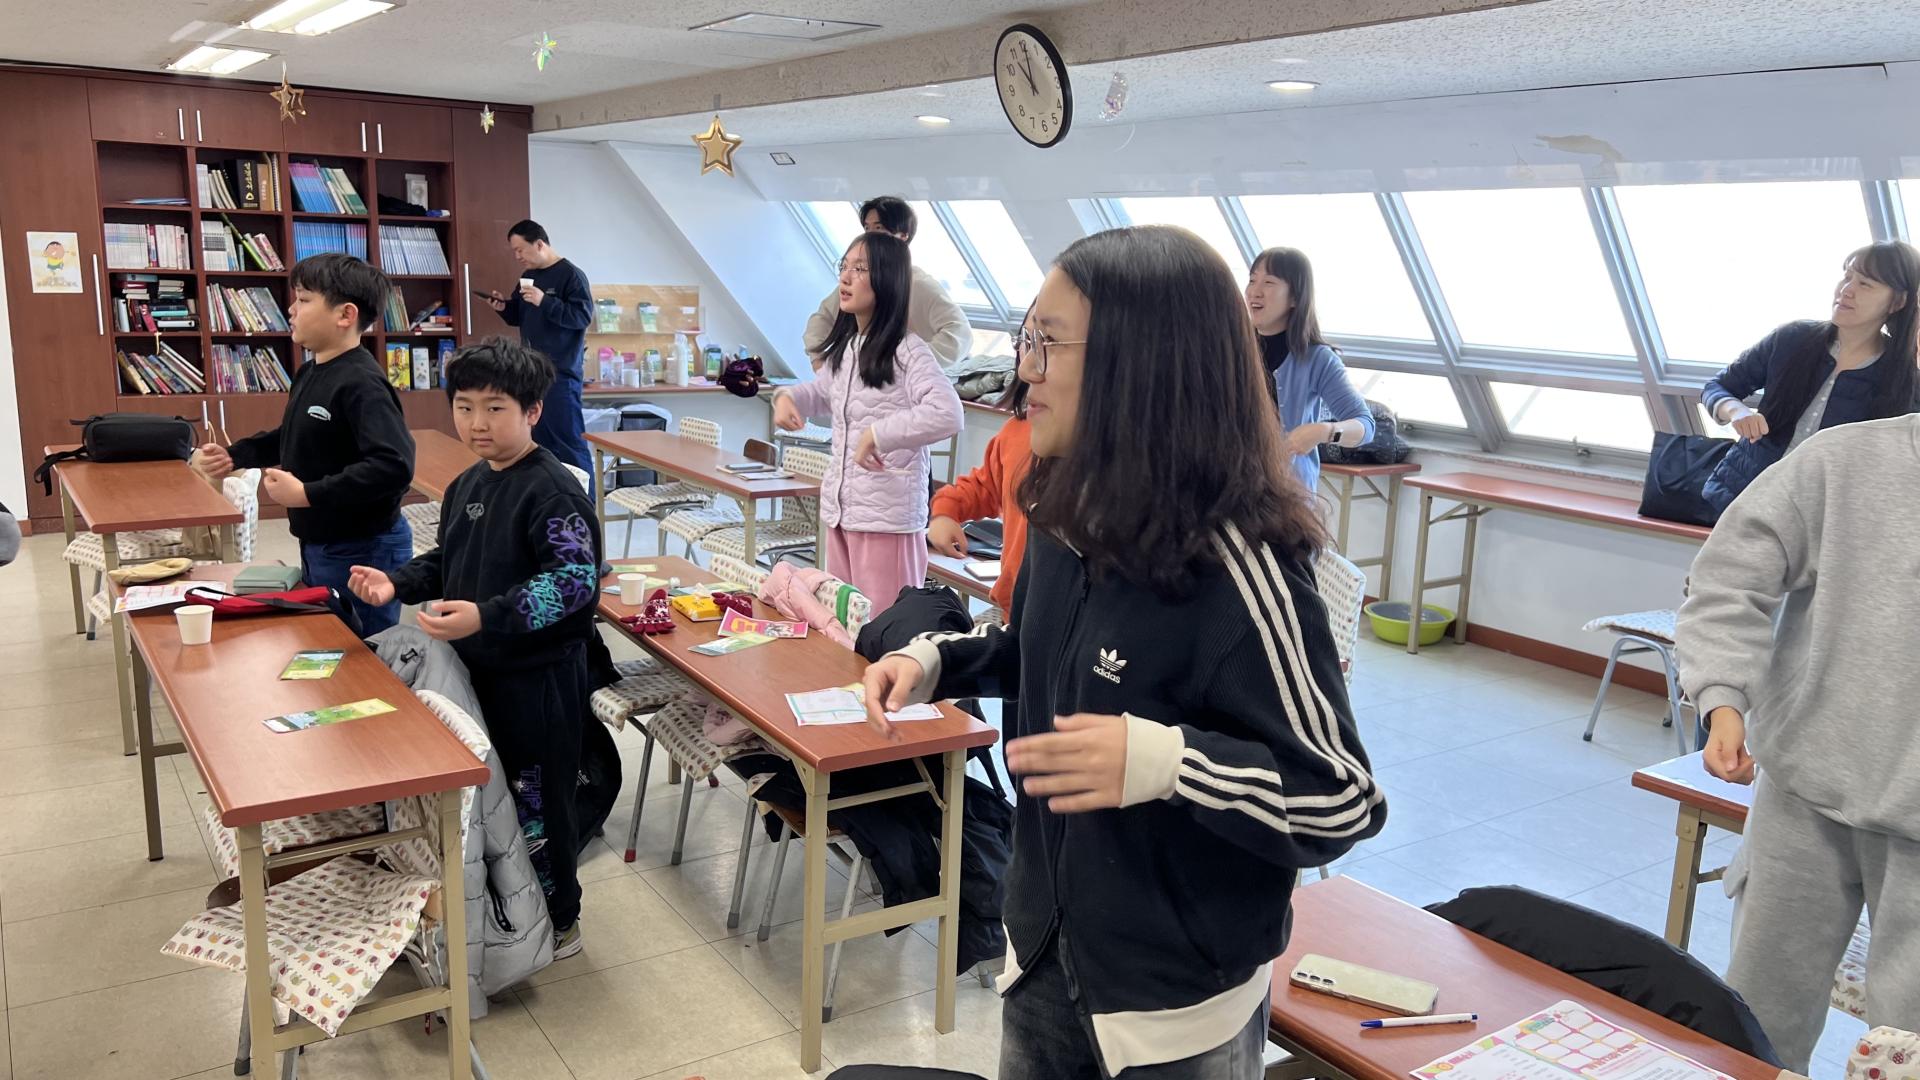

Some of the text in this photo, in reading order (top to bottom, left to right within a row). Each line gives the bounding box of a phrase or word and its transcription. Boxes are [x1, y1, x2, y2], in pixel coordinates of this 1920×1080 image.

[1019, 40, 1028, 53] 12
[1033, 43, 1039, 57] 1
[1010, 48, 1018, 60] 11
[1044, 56, 1052, 69] 2
[1006, 63, 1016, 76] 10
[1054, 76, 1061, 90] 3
[1008, 84, 1016, 97] 9
[1018, 104, 1026, 117] 8
[1056, 98, 1063, 111] 4
[1029, 116, 1036, 129] 7
[1051, 112, 1059, 126] 5
[1041, 119, 1049, 133] 6
[1093, 665, 1121, 684] adidas
